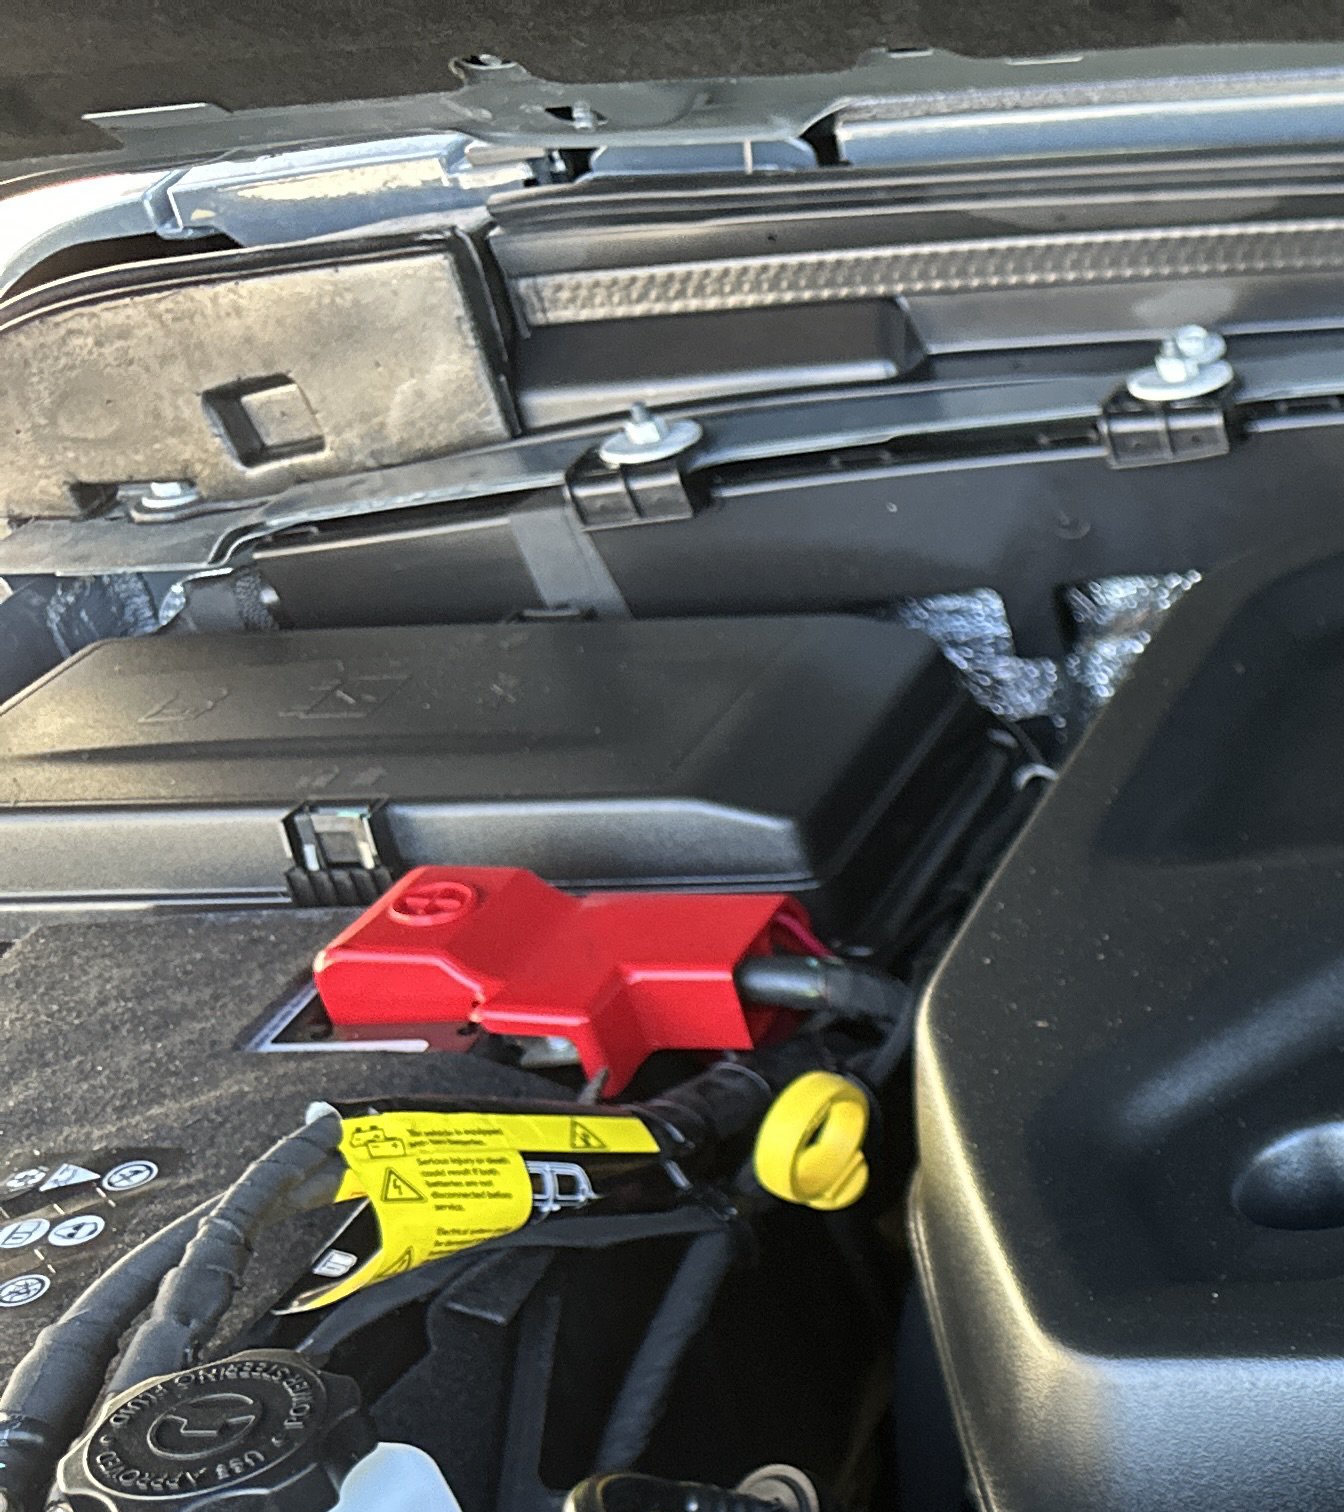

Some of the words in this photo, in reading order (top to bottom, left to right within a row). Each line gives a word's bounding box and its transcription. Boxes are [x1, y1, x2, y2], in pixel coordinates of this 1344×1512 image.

[416, 1158, 449, 1166] Serious
[449, 1156, 475, 1166] injury
[431, 1191, 486, 1199] disconnected
[487, 1191, 513, 1199] before
[95, 1450, 208, 1491] APPROVED
